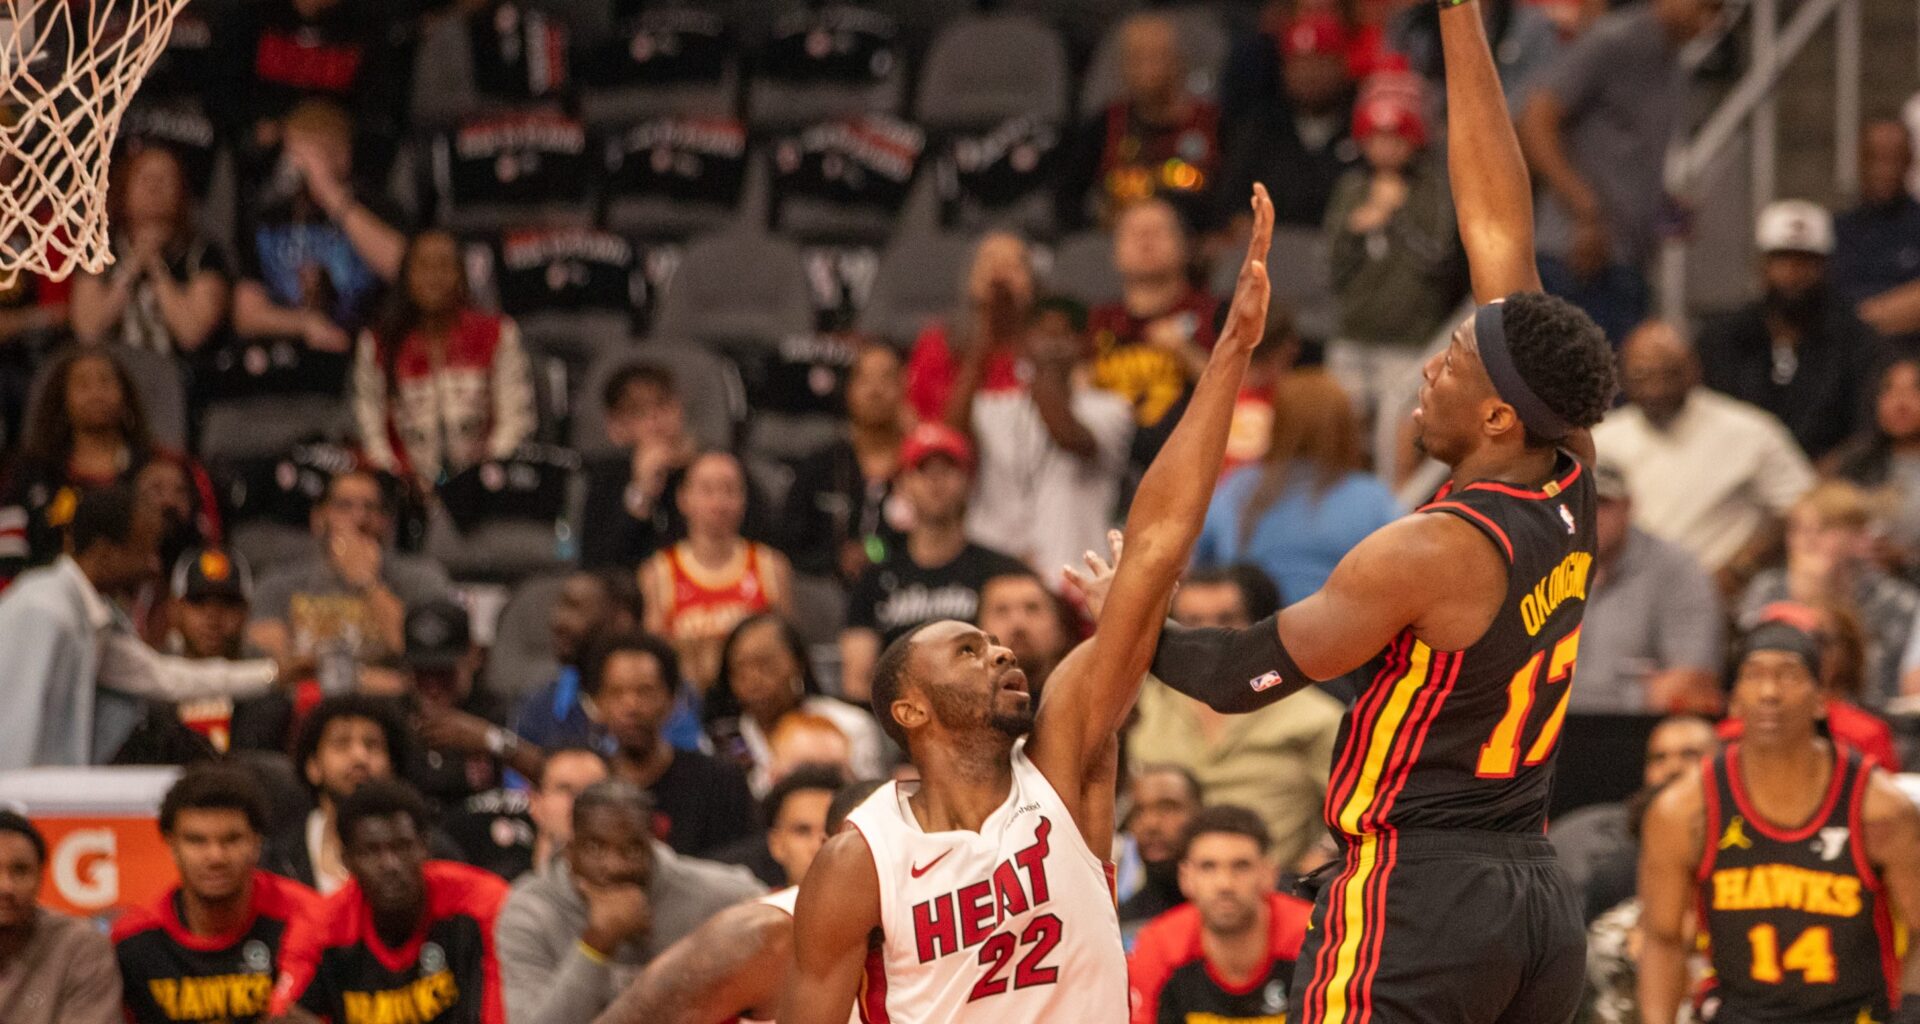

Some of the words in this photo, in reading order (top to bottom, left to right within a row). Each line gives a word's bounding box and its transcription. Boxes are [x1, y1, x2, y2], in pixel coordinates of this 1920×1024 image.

[1475, 621, 1582, 778] 17
[51, 828, 119, 907] G
[912, 815, 1052, 964] HEAT
[1711, 863, 1863, 918] HAWKS
[967, 913, 1063, 1004] 22
[1747, 922, 1838, 984] 14
